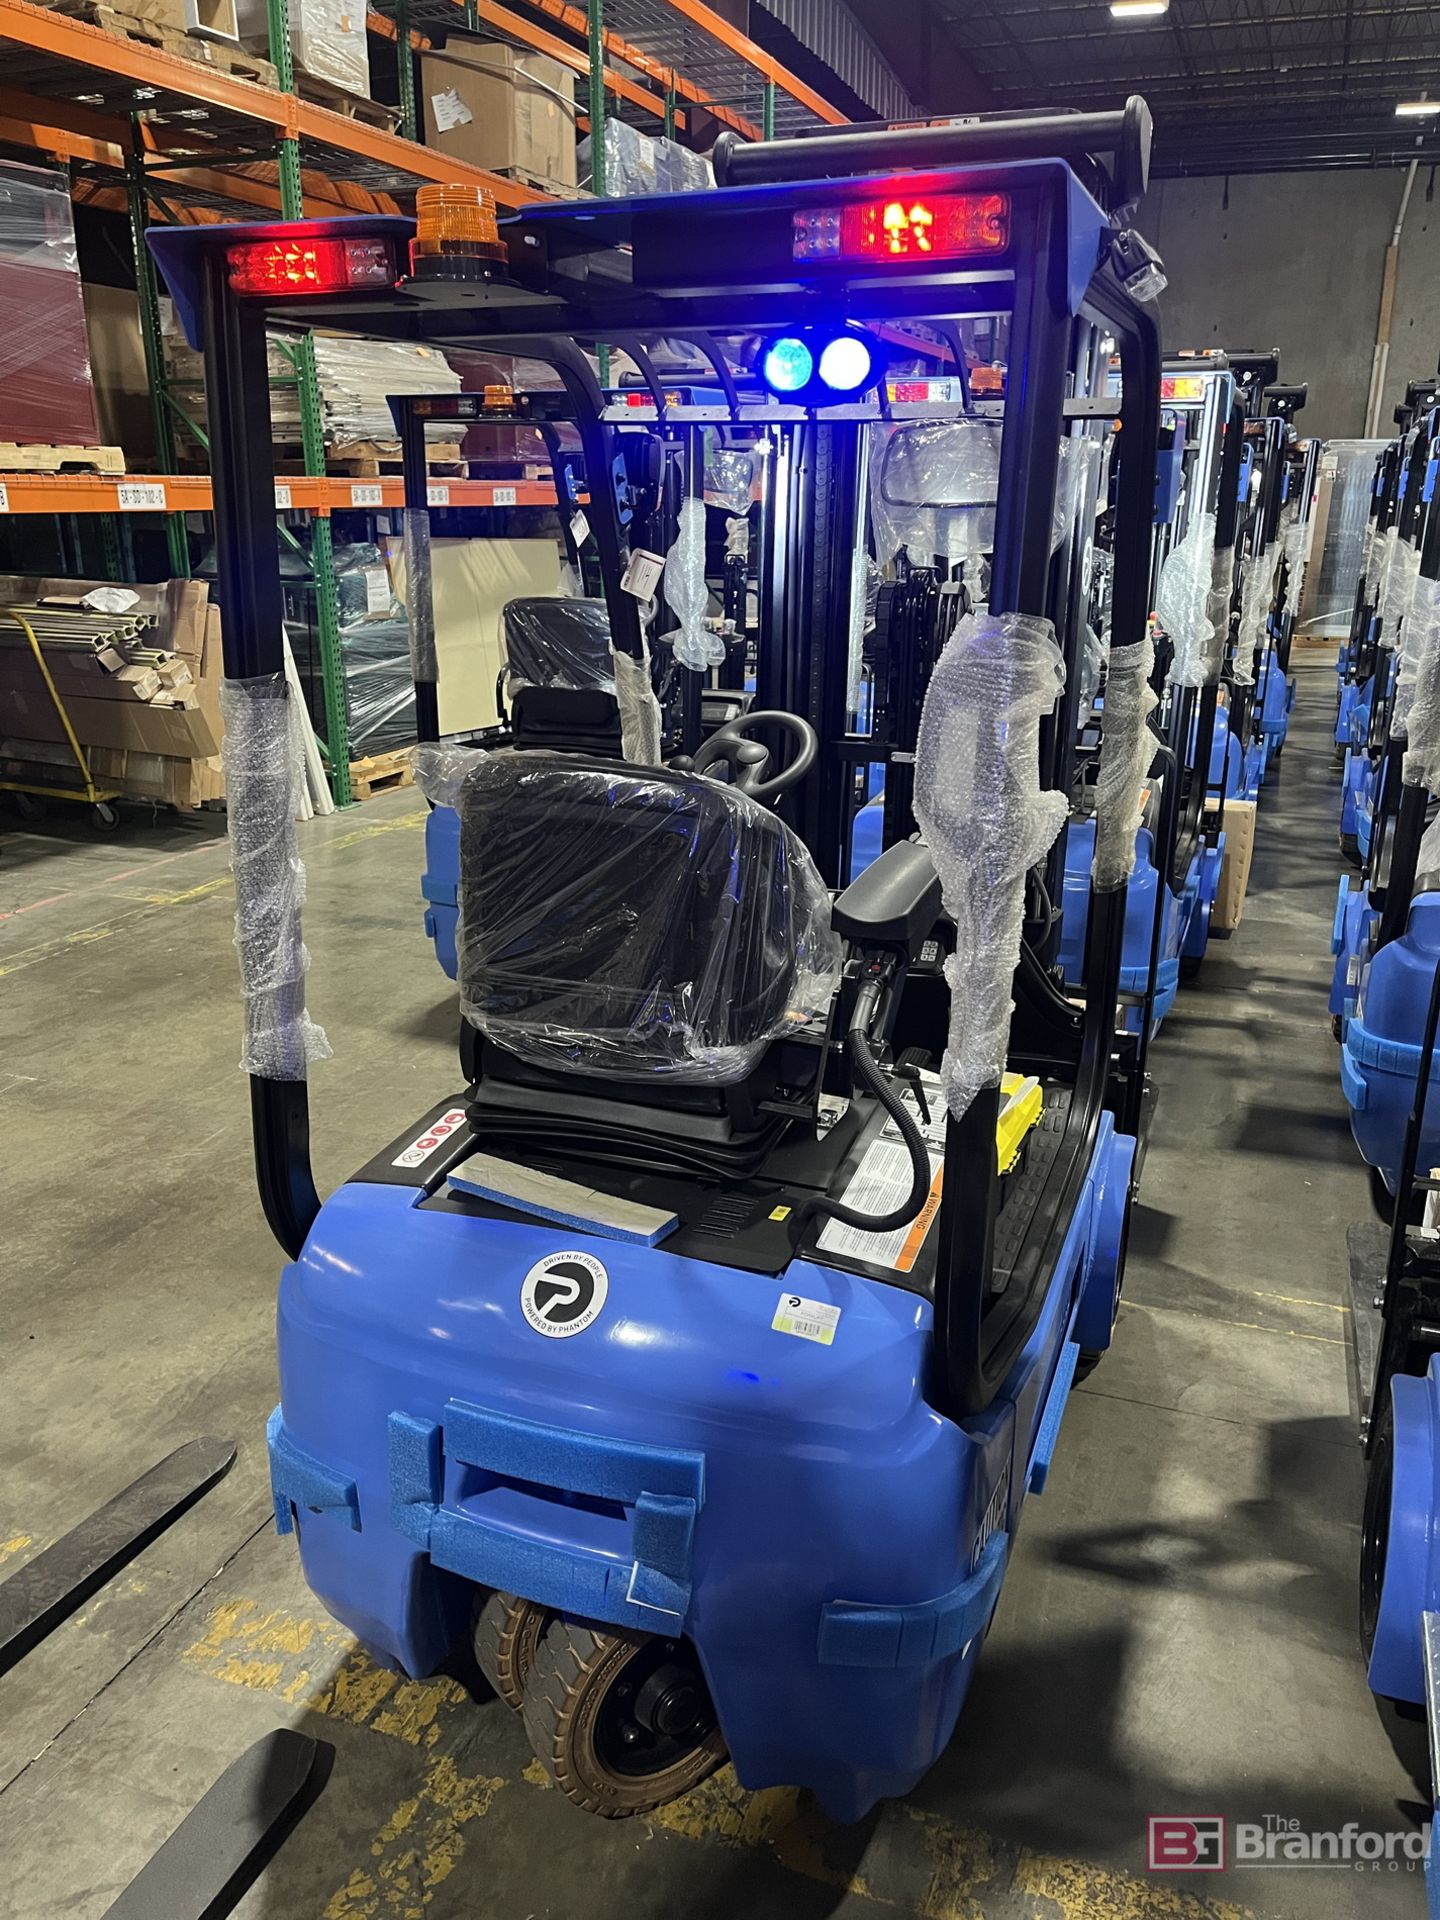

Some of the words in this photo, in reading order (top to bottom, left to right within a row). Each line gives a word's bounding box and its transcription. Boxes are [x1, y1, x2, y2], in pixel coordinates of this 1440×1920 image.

[915, 1198, 938, 1230] WARNING
[543, 1254, 572, 1267] DRIVEN
[583, 1257, 603, 1279] PEOPLE
[525, 1297, 548, 1330] POWERED
[558, 1310, 593, 1333] PHANTOM
